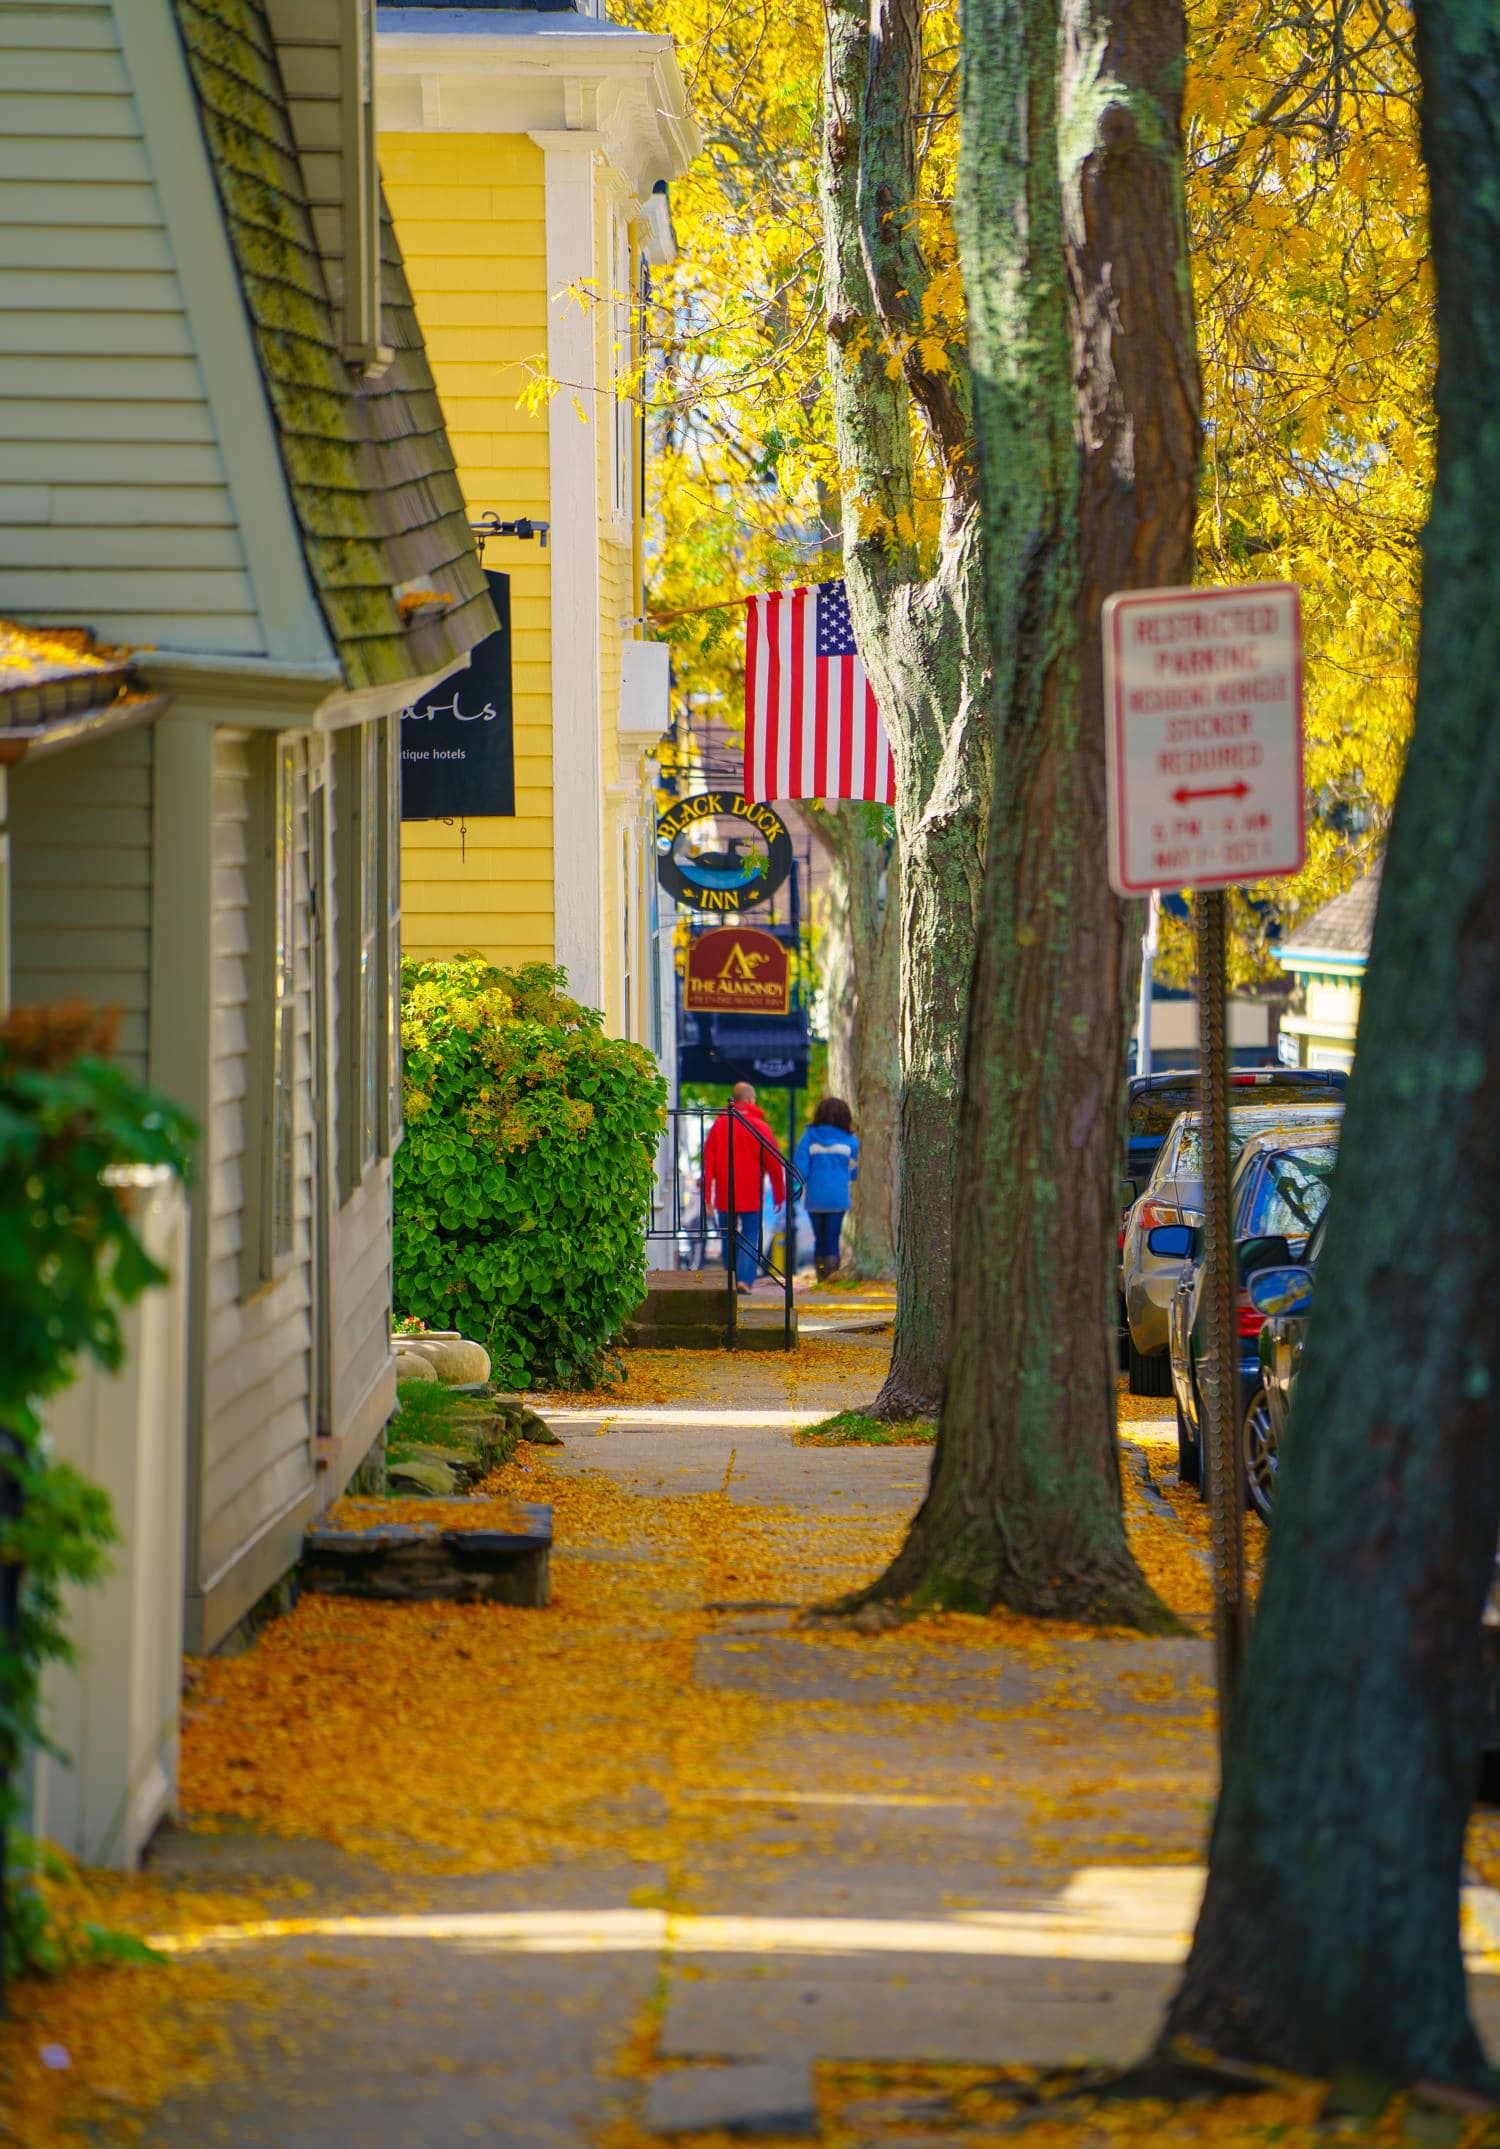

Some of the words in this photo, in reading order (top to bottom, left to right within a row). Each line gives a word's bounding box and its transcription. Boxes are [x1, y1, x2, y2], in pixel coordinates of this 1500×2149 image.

[1134, 604, 1279, 645] RESTRICTED
[1154, 643, 1261, 676] PARKING
[1165, 710, 1253, 742] STICKER
[433, 748, 466, 760] hotels
[1157, 742, 1264, 775] REQUIRED
[657, 794, 723, 842] BLACK
[731, 795, 785, 844] DUCK
[699, 889, 740, 910] INN
[690, 977, 716, 993] THE
